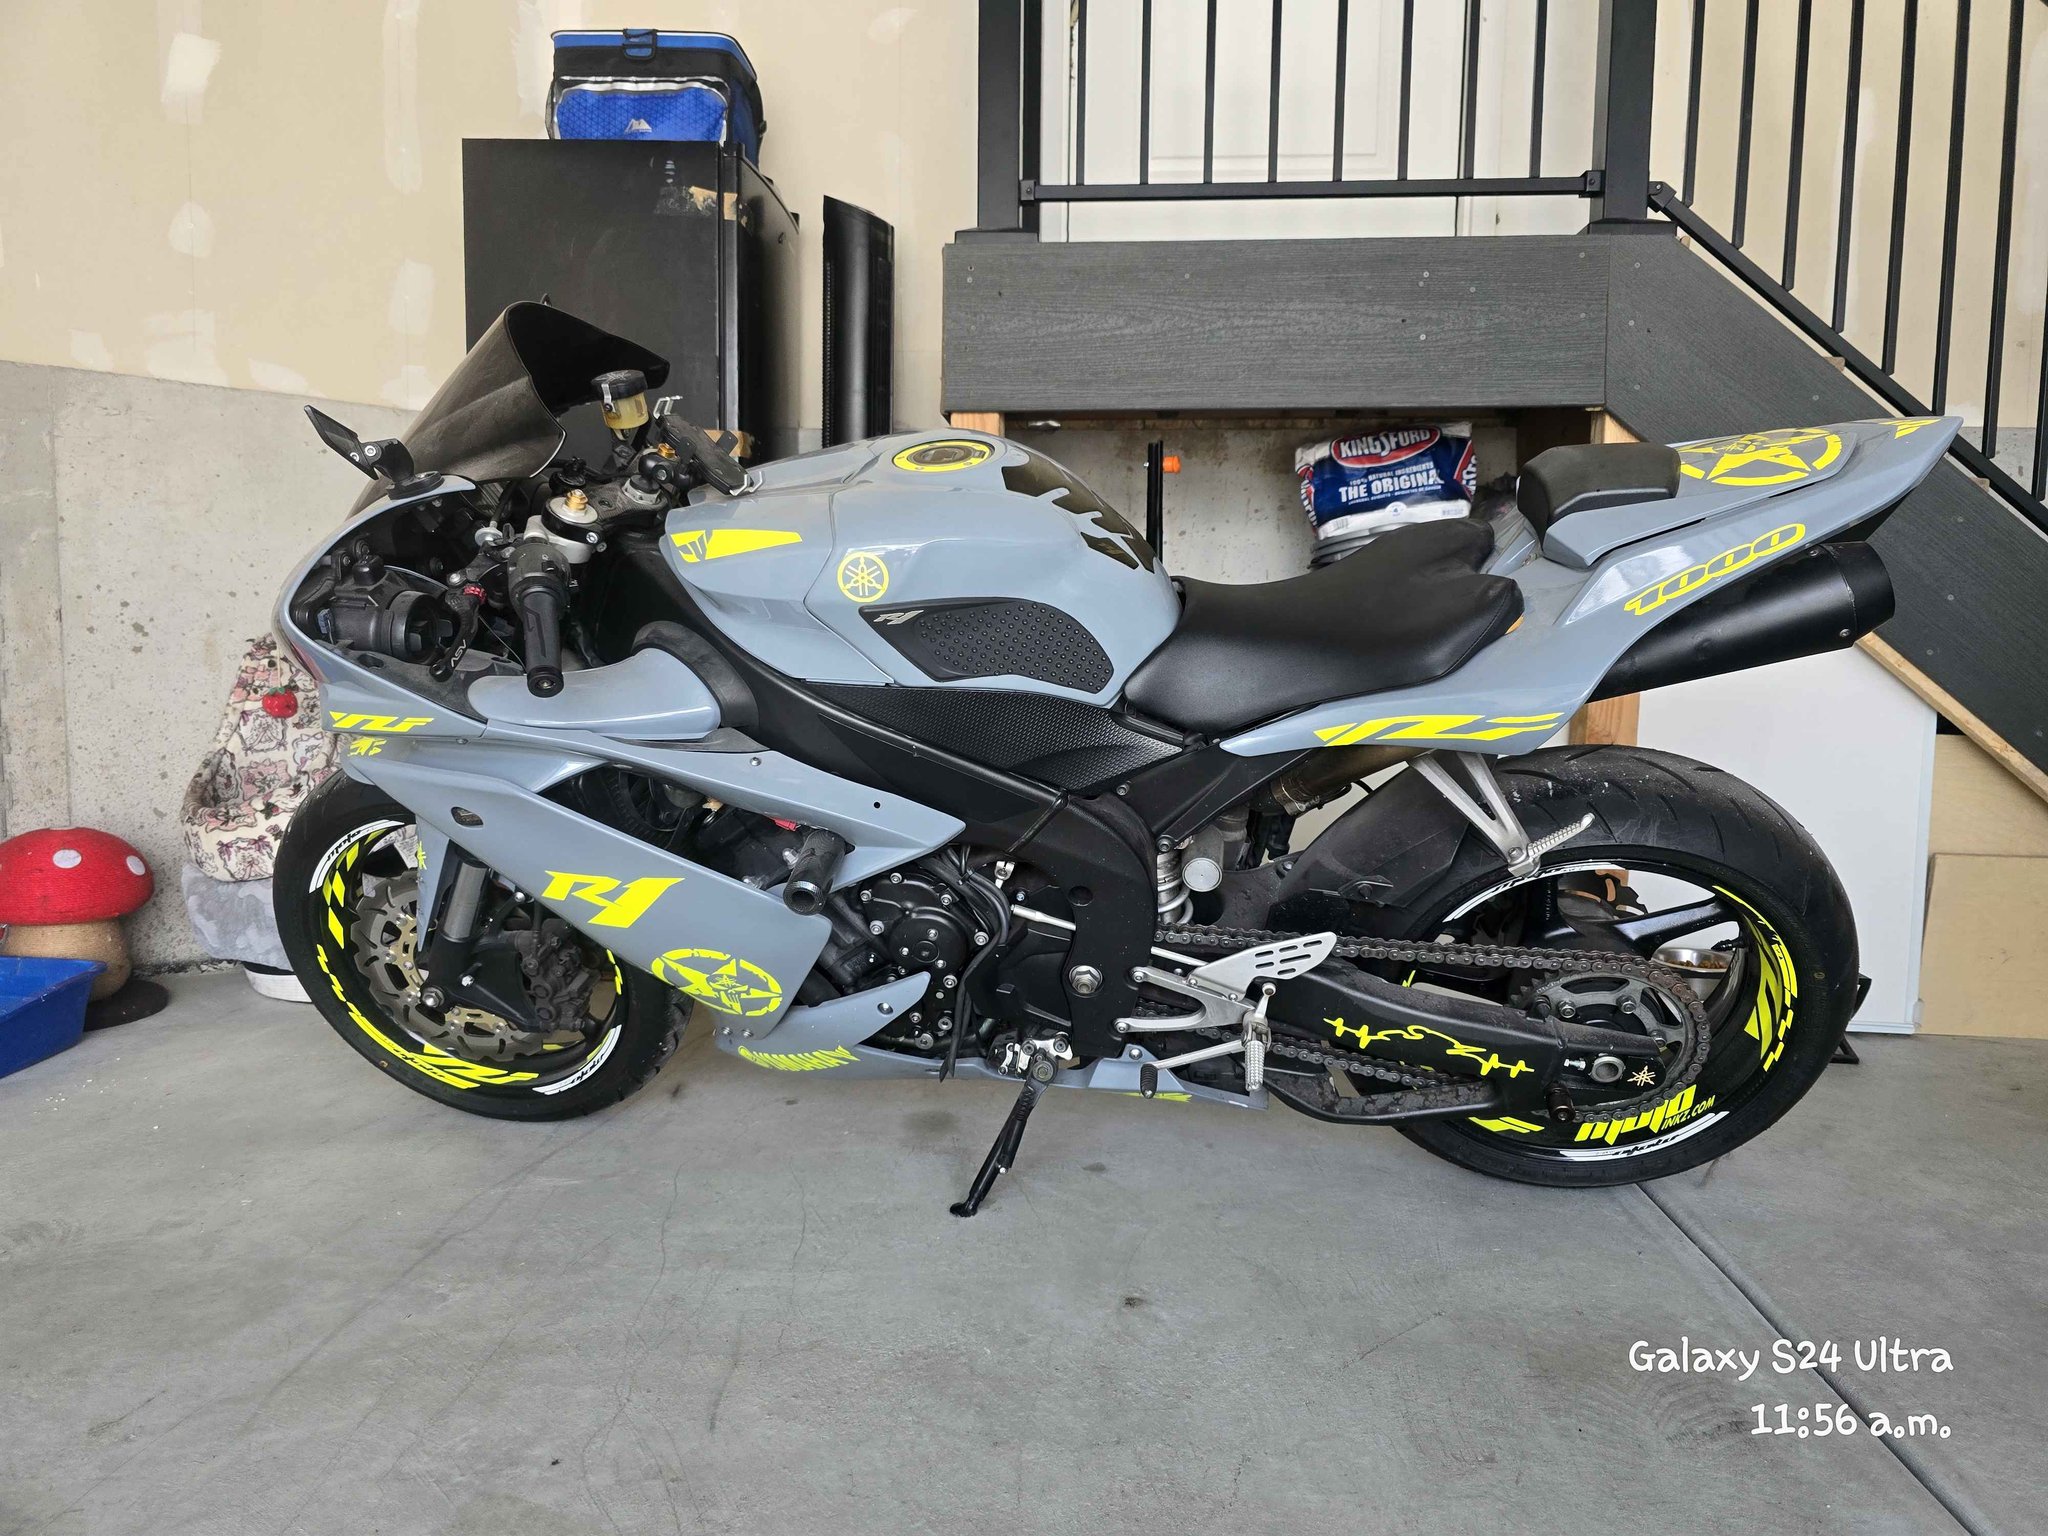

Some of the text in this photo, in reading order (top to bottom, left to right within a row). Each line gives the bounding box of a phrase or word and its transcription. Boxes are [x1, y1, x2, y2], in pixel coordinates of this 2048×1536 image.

[1340, 429, 1431, 458] KINGSFORD
[1338, 484, 1368, 503] THE
[1623, 523, 1806, 616] 1000
[873, 609, 925, 625] R1
[541, 870, 686, 929] R1
[1660, 1094, 1716, 1131] INKZ.COM
